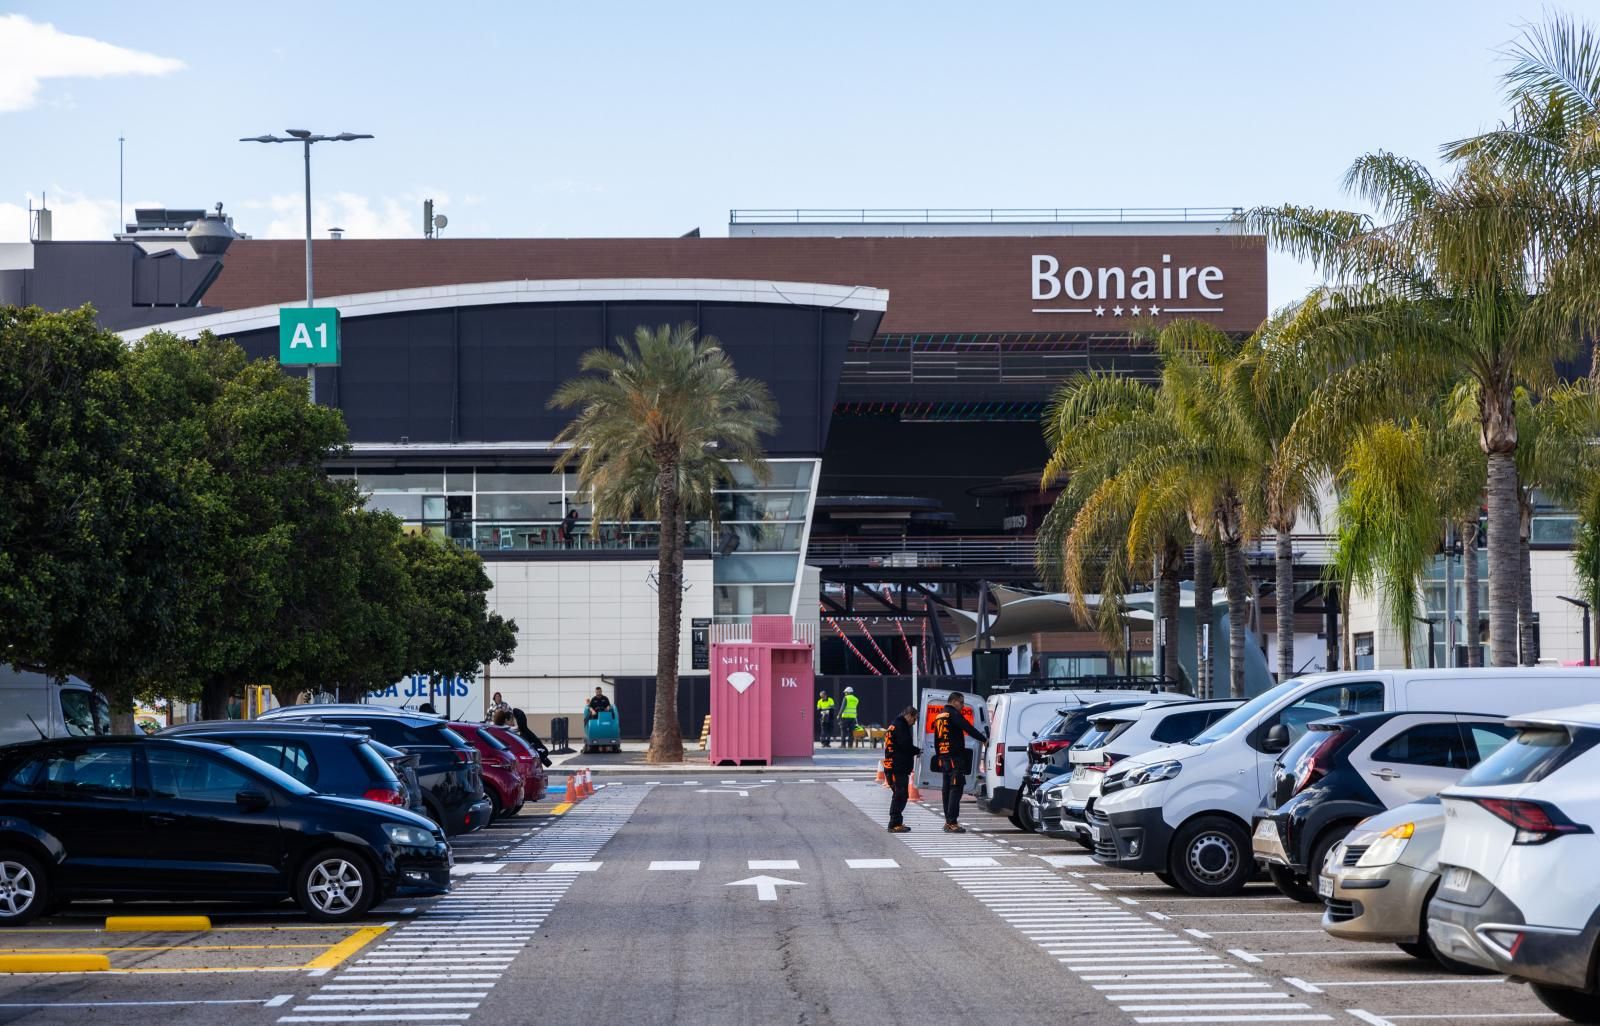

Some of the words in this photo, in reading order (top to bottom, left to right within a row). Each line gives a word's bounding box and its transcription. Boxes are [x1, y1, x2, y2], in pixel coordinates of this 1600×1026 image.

[1031, 254, 1224, 301] Bonaire
[289, 322, 328, 349] A1
[781, 677, 798, 688] DK
